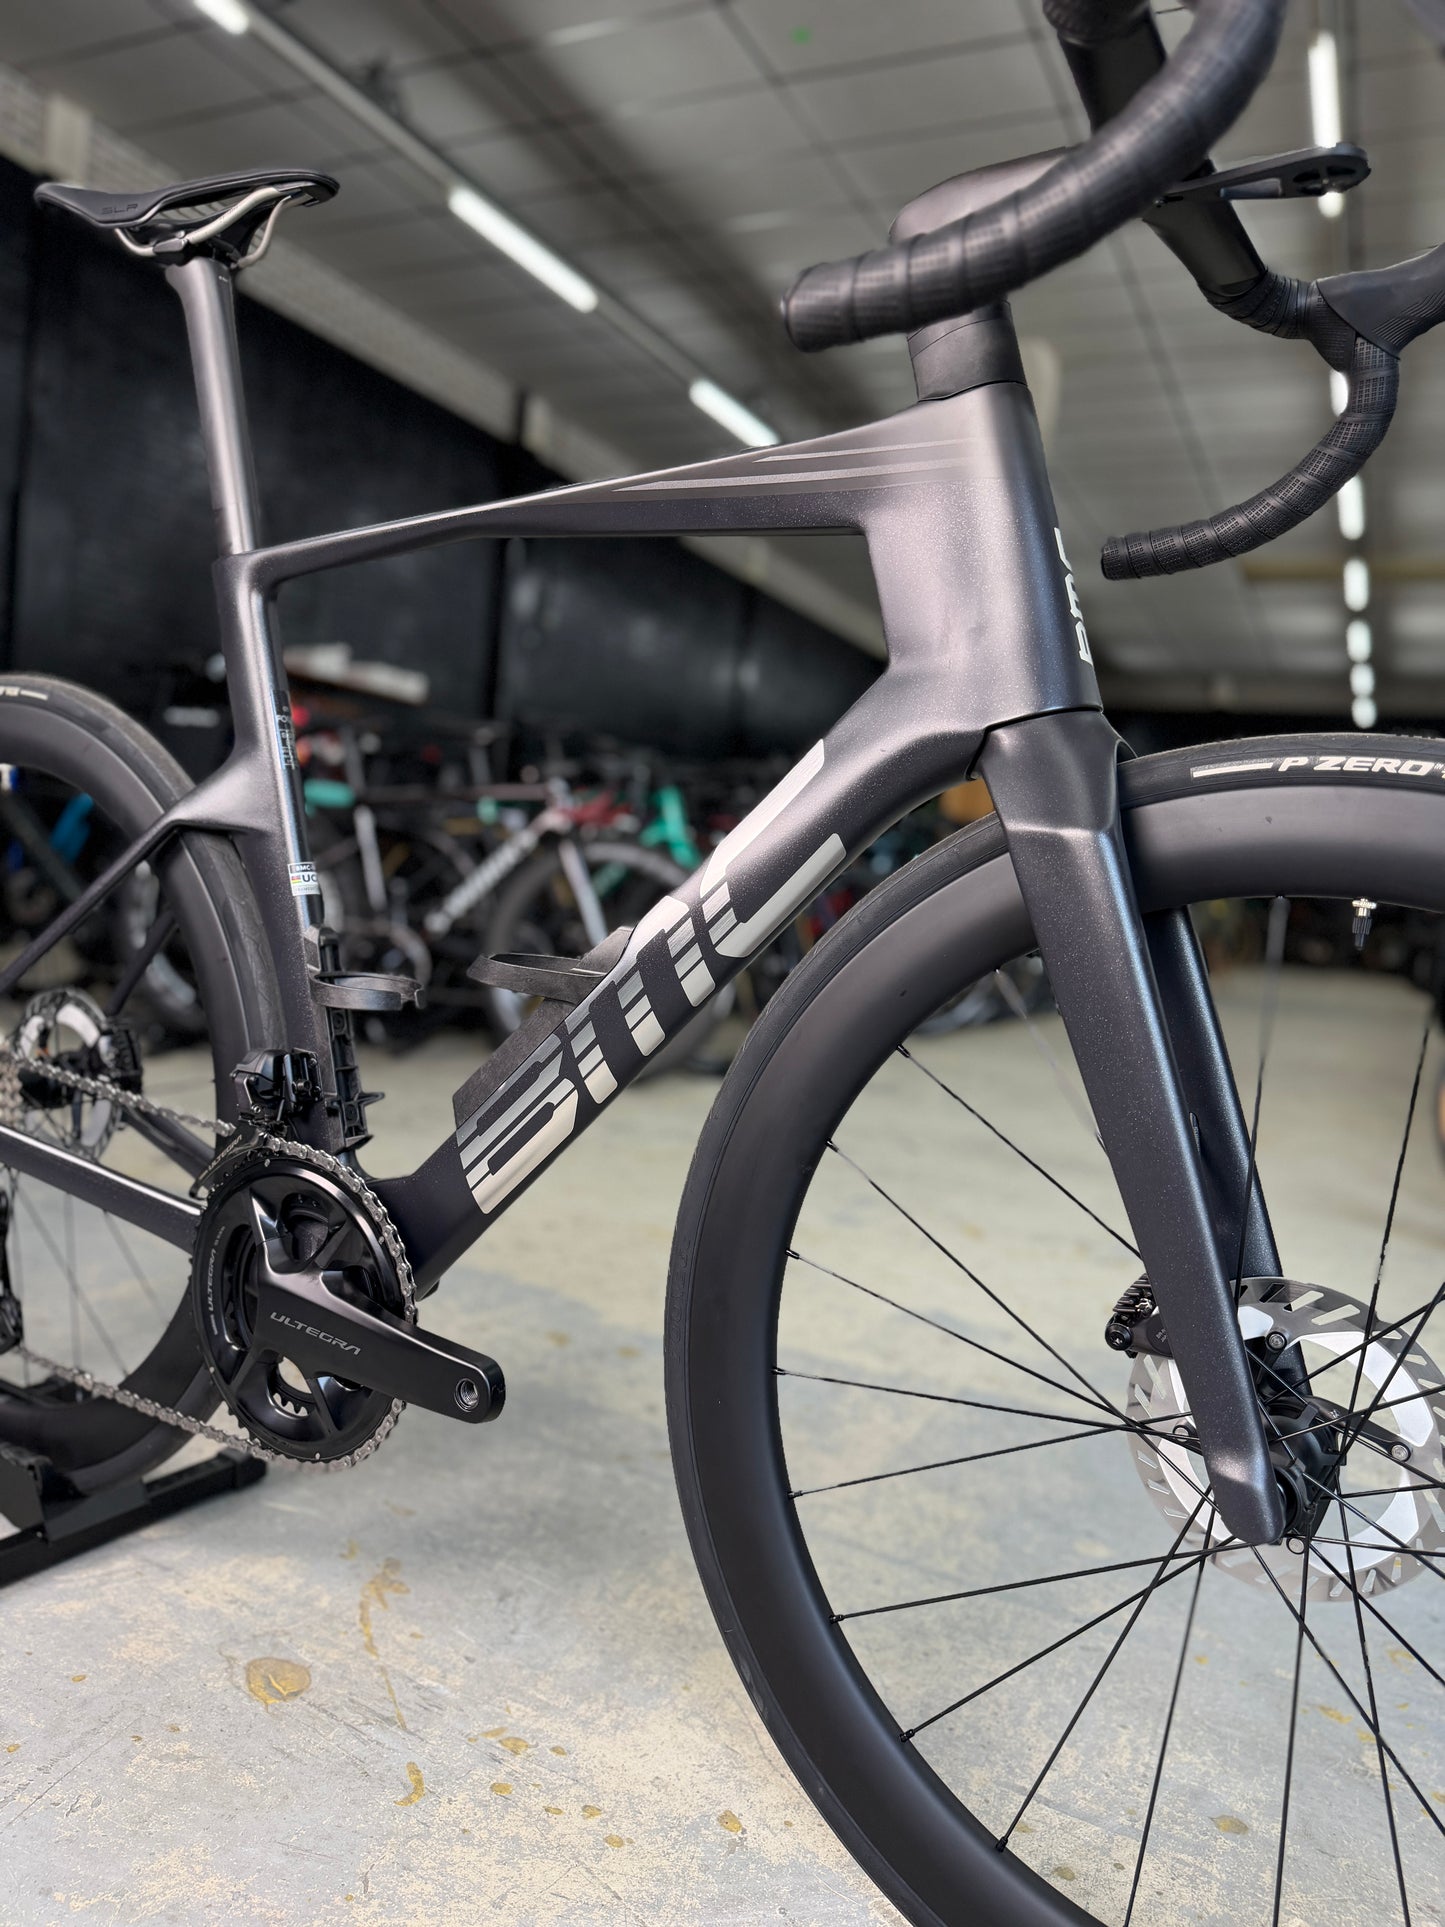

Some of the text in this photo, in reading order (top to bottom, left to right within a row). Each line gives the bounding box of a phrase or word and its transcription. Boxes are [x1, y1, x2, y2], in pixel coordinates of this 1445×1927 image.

[1278, 757, 1309, 772] P
[1313, 756, 1435, 776] ZERO
[208, 1134, 242, 1171] ULTEGRA
[207, 1248, 217, 1312] ULTEGRA
[270, 1311, 361, 1355] ULTEGRA
